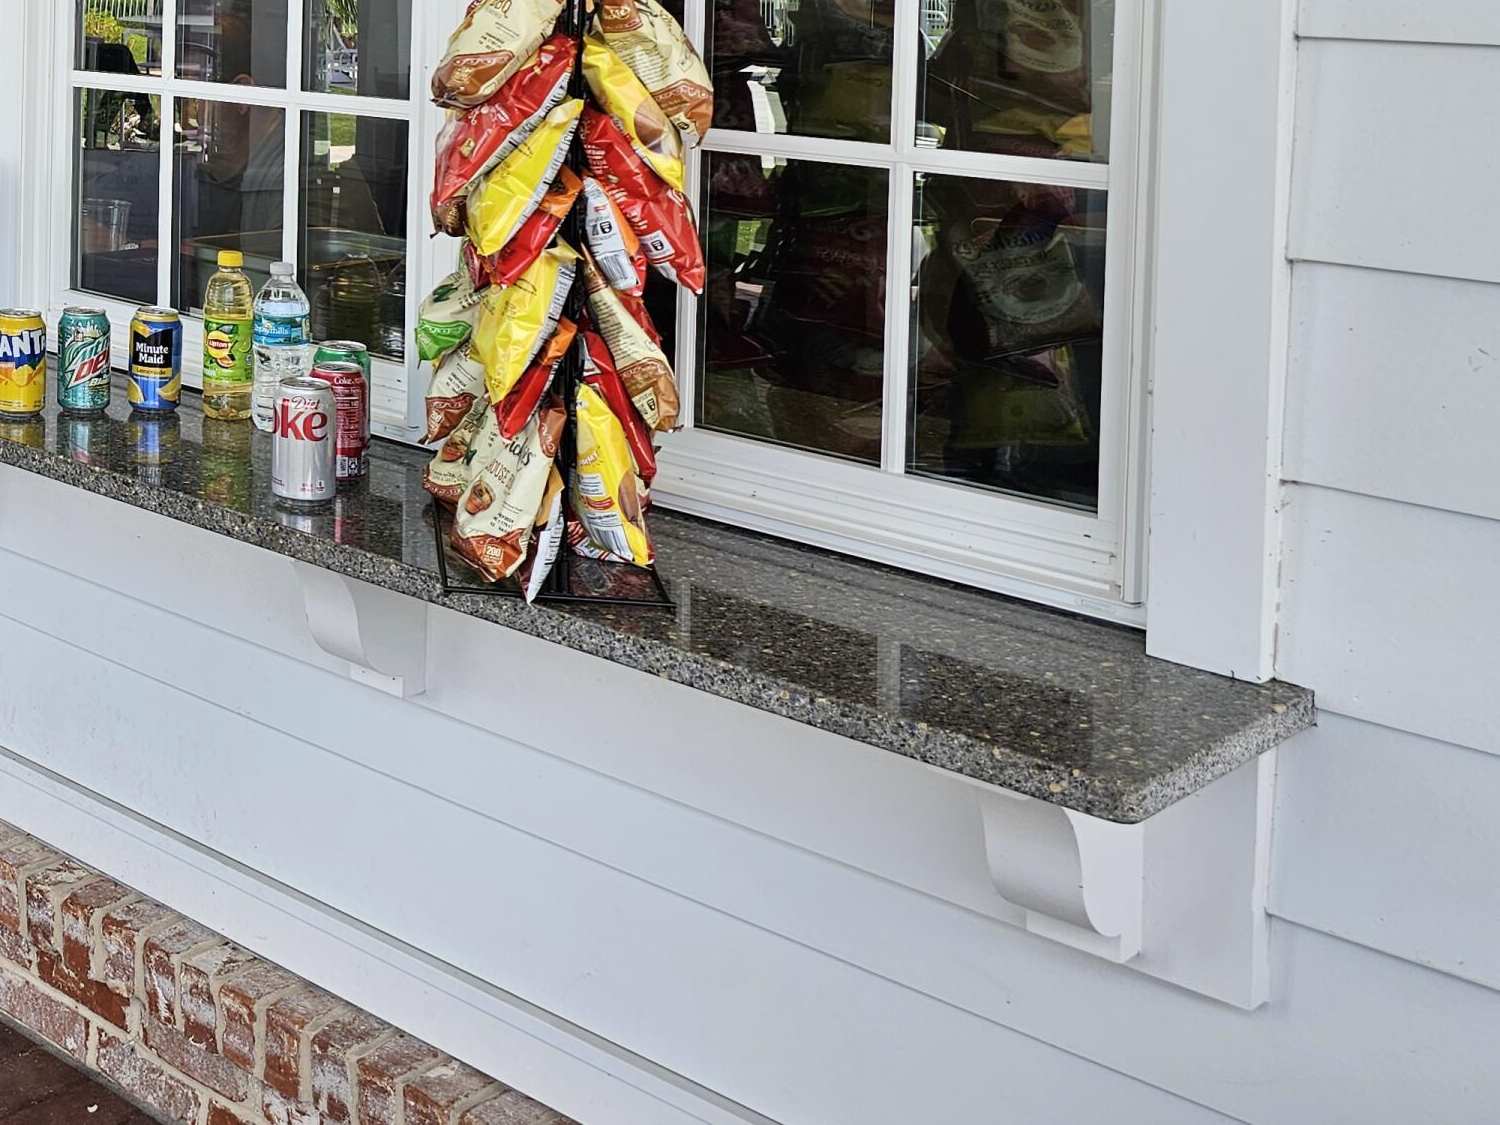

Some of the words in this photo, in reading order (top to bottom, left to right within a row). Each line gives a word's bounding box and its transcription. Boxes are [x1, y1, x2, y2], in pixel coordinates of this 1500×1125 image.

[135, 341, 169, 355] Minute
[208, 340, 229, 349] Lipton
[138, 353, 164, 365] Maid
[291, 395, 321, 411] Diet
